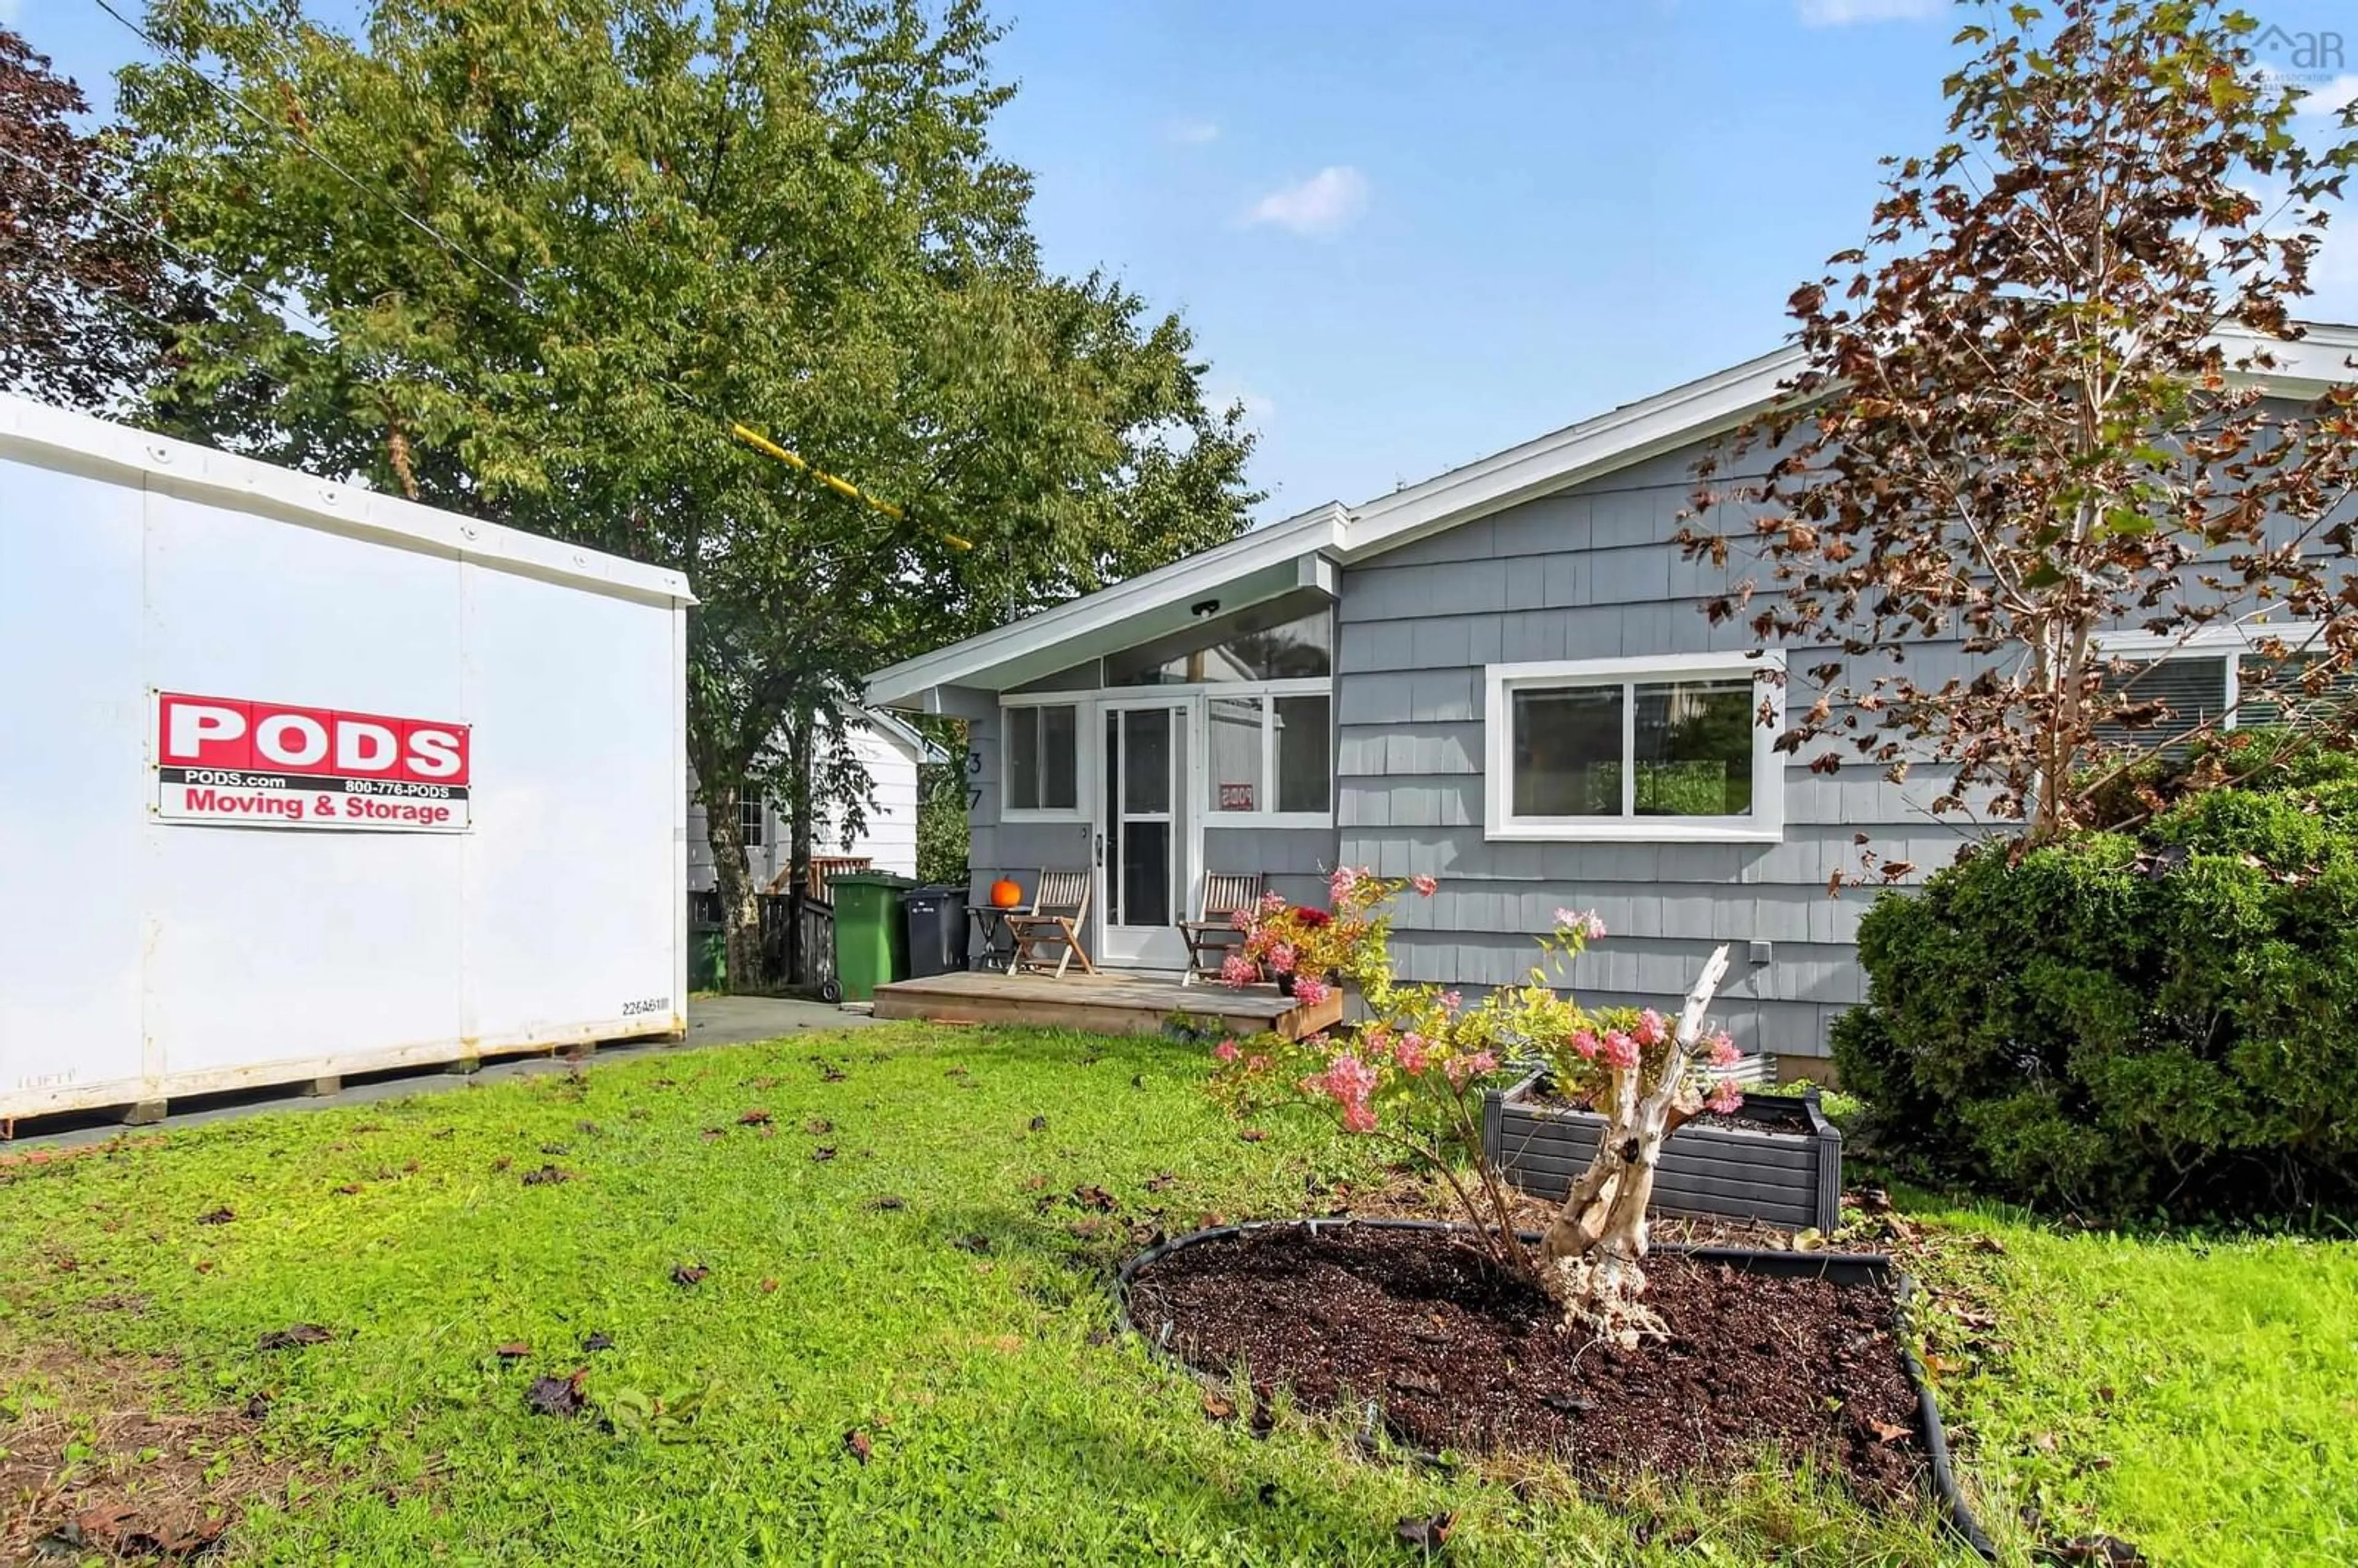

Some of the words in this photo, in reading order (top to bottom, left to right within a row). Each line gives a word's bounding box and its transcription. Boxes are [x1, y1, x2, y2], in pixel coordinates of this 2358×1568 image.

[169, 702, 462, 778] PODS
[185, 770, 286, 788] PODS.com
[345, 780, 449, 799] 800-776-PODS
[185, 788, 303, 820] Moving
[314, 794, 336, 817] &
[346, 798, 449, 824] Storage
